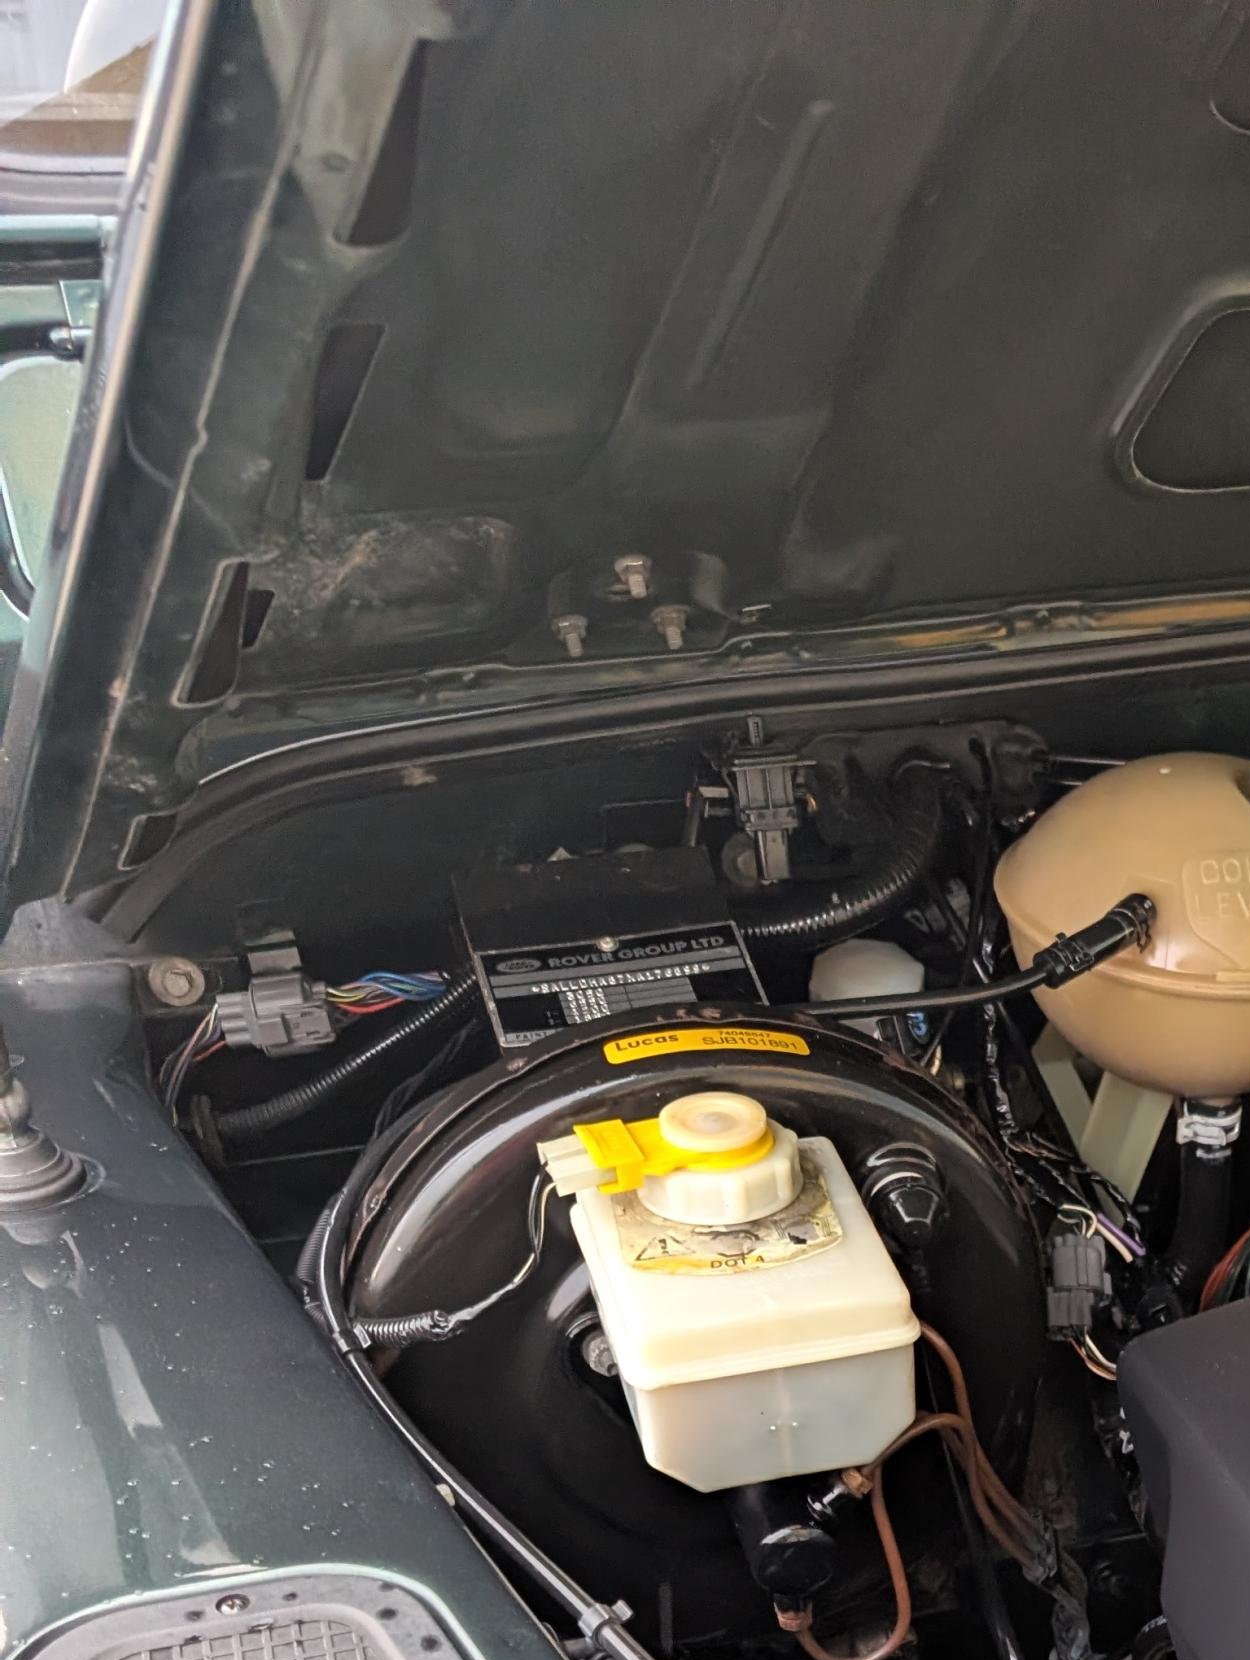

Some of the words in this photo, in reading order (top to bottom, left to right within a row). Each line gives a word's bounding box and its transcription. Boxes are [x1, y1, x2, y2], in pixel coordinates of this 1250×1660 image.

[548, 952, 615, 968] ROVER
[618, 940, 687, 959] GROUP
[690, 935, 725, 949] LTD
[615, 1034, 679, 1051] Lucas
[710, 1255, 747, 1268] DOT
